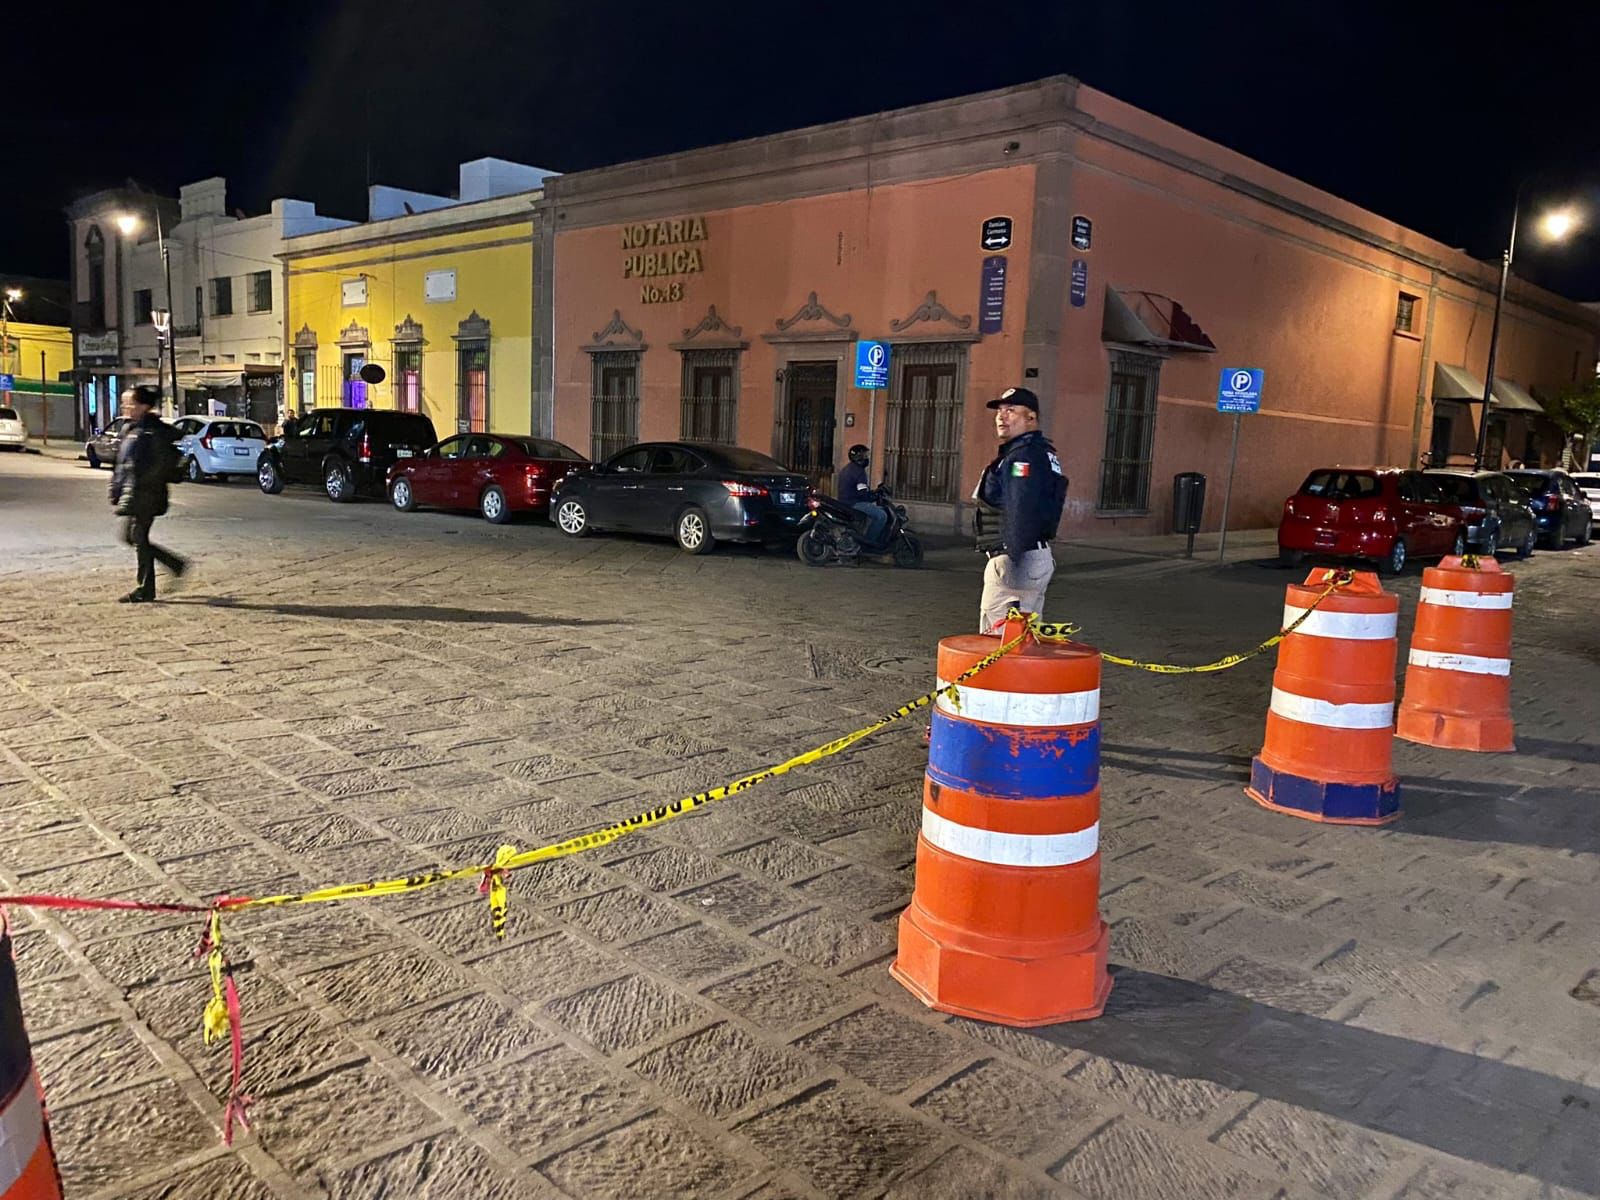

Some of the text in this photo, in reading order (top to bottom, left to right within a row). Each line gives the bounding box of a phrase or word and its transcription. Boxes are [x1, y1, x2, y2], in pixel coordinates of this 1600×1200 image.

[621, 217, 708, 249] NOTARIA
[623, 249, 704, 279] PUBLICA
[873, 348, 882, 364] P
[1236, 374, 1249, 389] P
